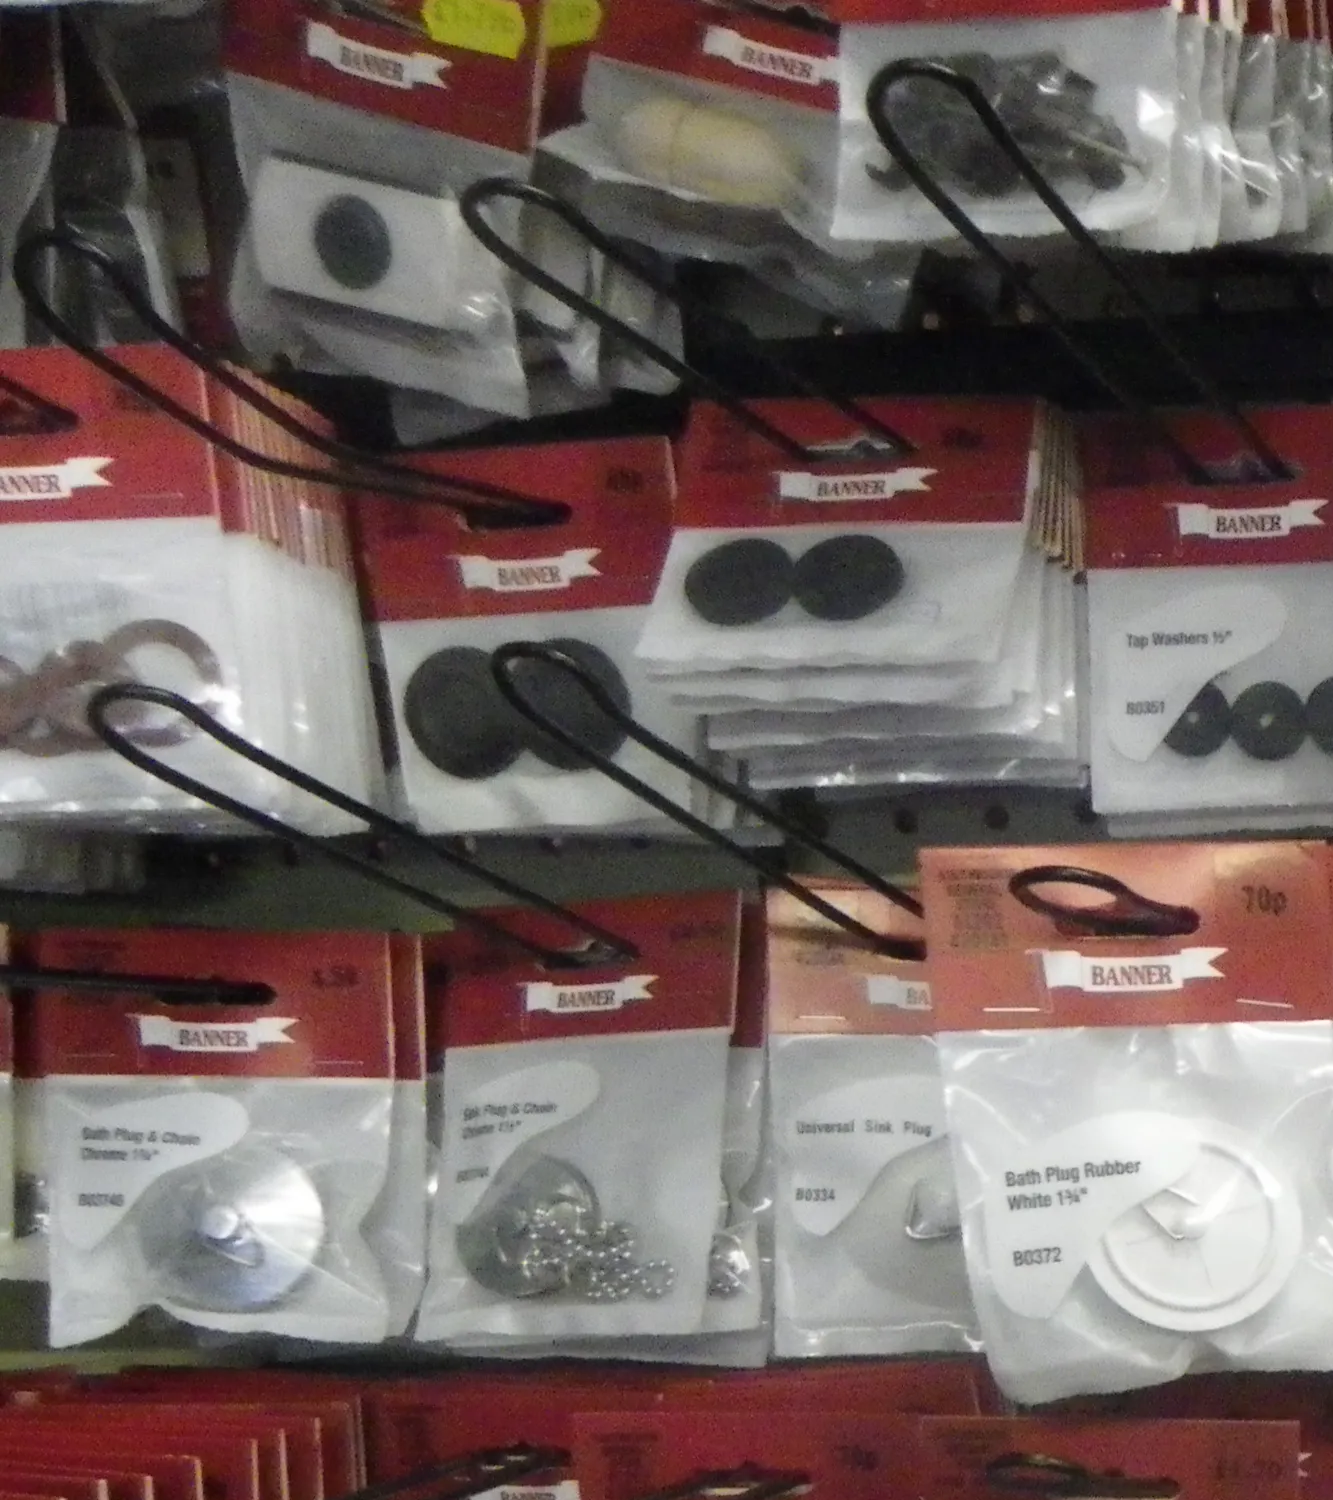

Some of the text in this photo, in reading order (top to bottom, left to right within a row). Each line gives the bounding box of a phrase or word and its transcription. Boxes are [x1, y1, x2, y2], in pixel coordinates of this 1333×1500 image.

[340, 45, 405, 81] BANNER
[742, 46, 813, 79] BANNER
[816, 478, 887, 498] BANNER
[1215, 514, 1281, 534] BANNER
[497, 564, 561, 586] BANNER
[1126, 630, 1209, 650] Tap Washers
[1091, 963, 1173, 987] BANNER
[556, 989, 616, 1007] BANNER
[179, 1029, 248, 1048] BANNER
[796, 1120, 933, 1138] Universal Sink Plug
[1005, 1159, 1142, 1188] Bath Plug Rubber
[1006, 1193, 1053, 1212] White
[1012, 1247, 1063, 1267] B0372
